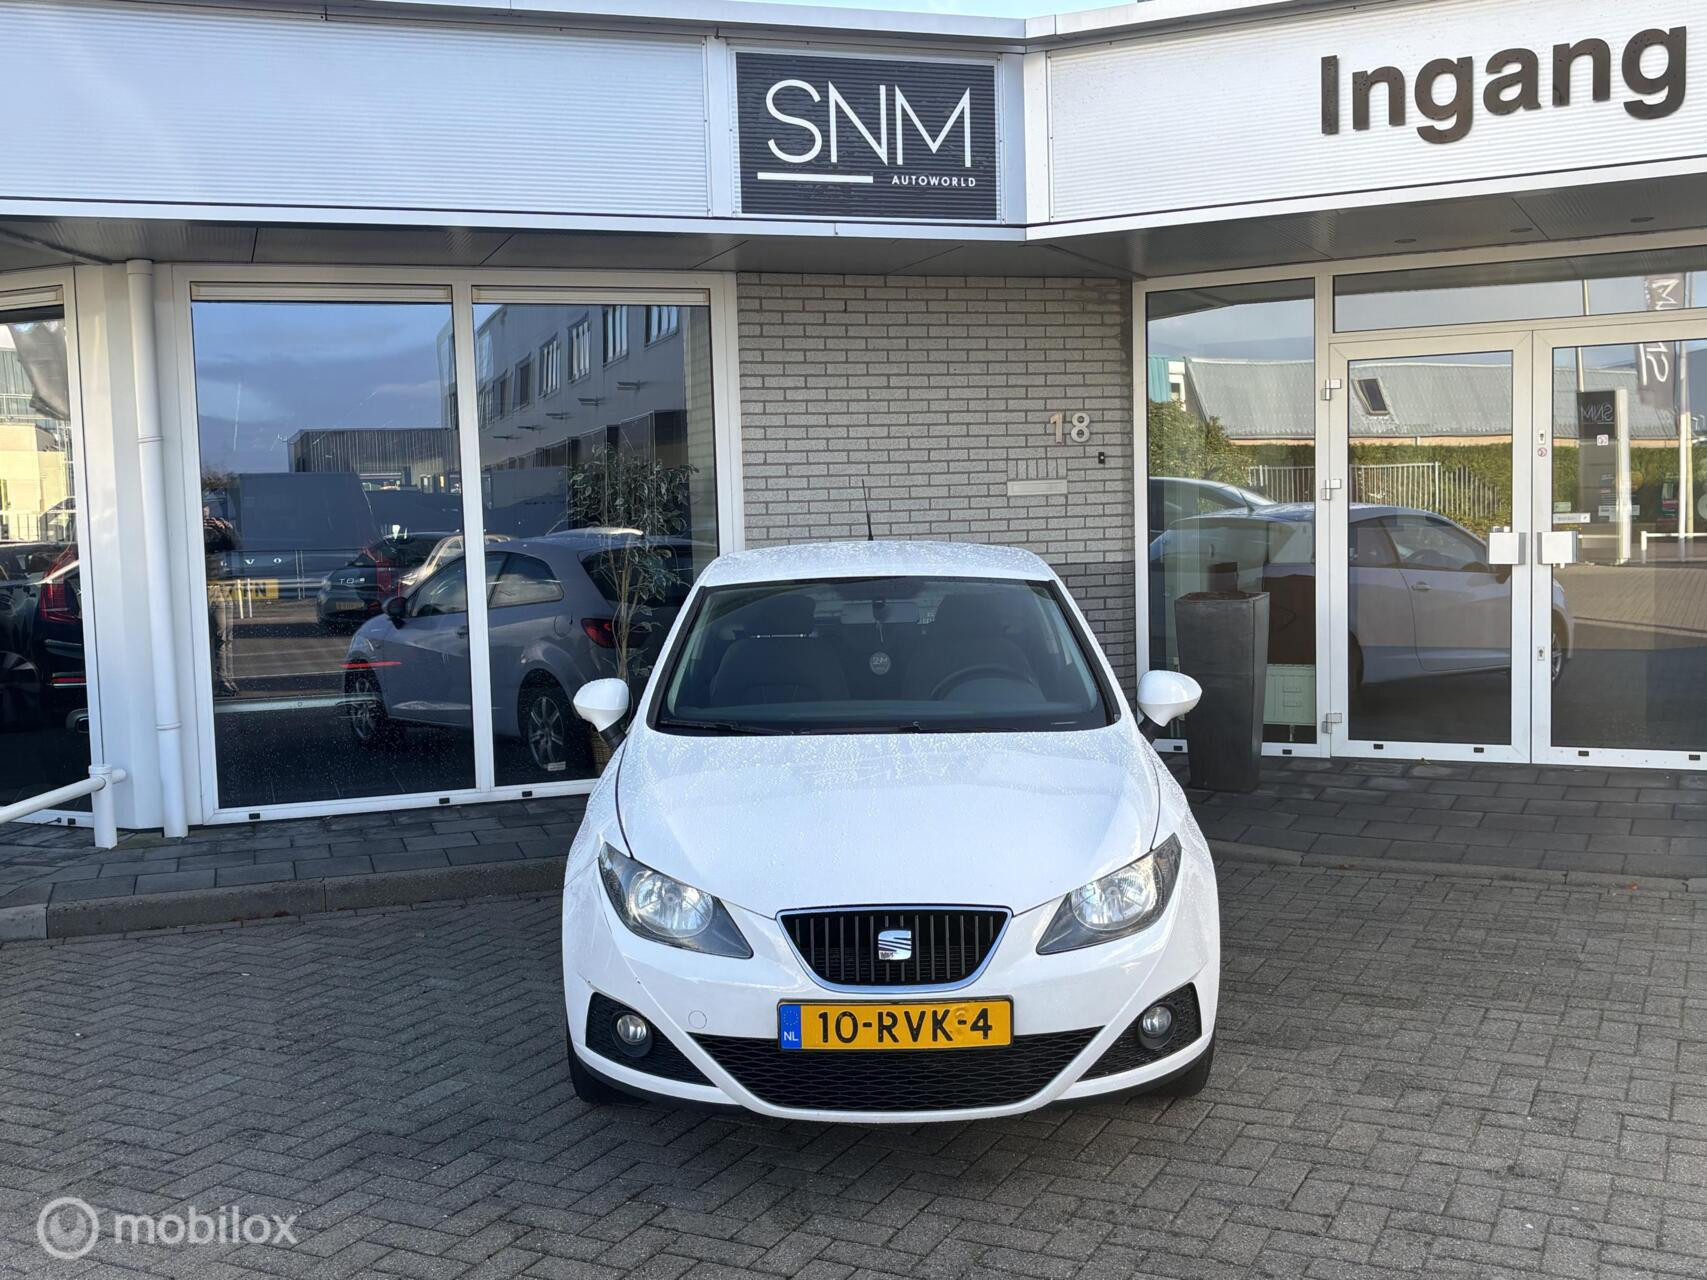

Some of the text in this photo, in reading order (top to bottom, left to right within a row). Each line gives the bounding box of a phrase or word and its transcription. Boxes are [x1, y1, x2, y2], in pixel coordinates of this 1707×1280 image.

[1321, 26, 1687, 144] Ingang
[766, 79, 972, 168] SNM
[892, 175, 976, 187] AUTOWORLD
[1050, 411, 1090, 442] 18
[783, 1031, 799, 1042] NL
[818, 1008, 993, 1043] 10-RVK-4
